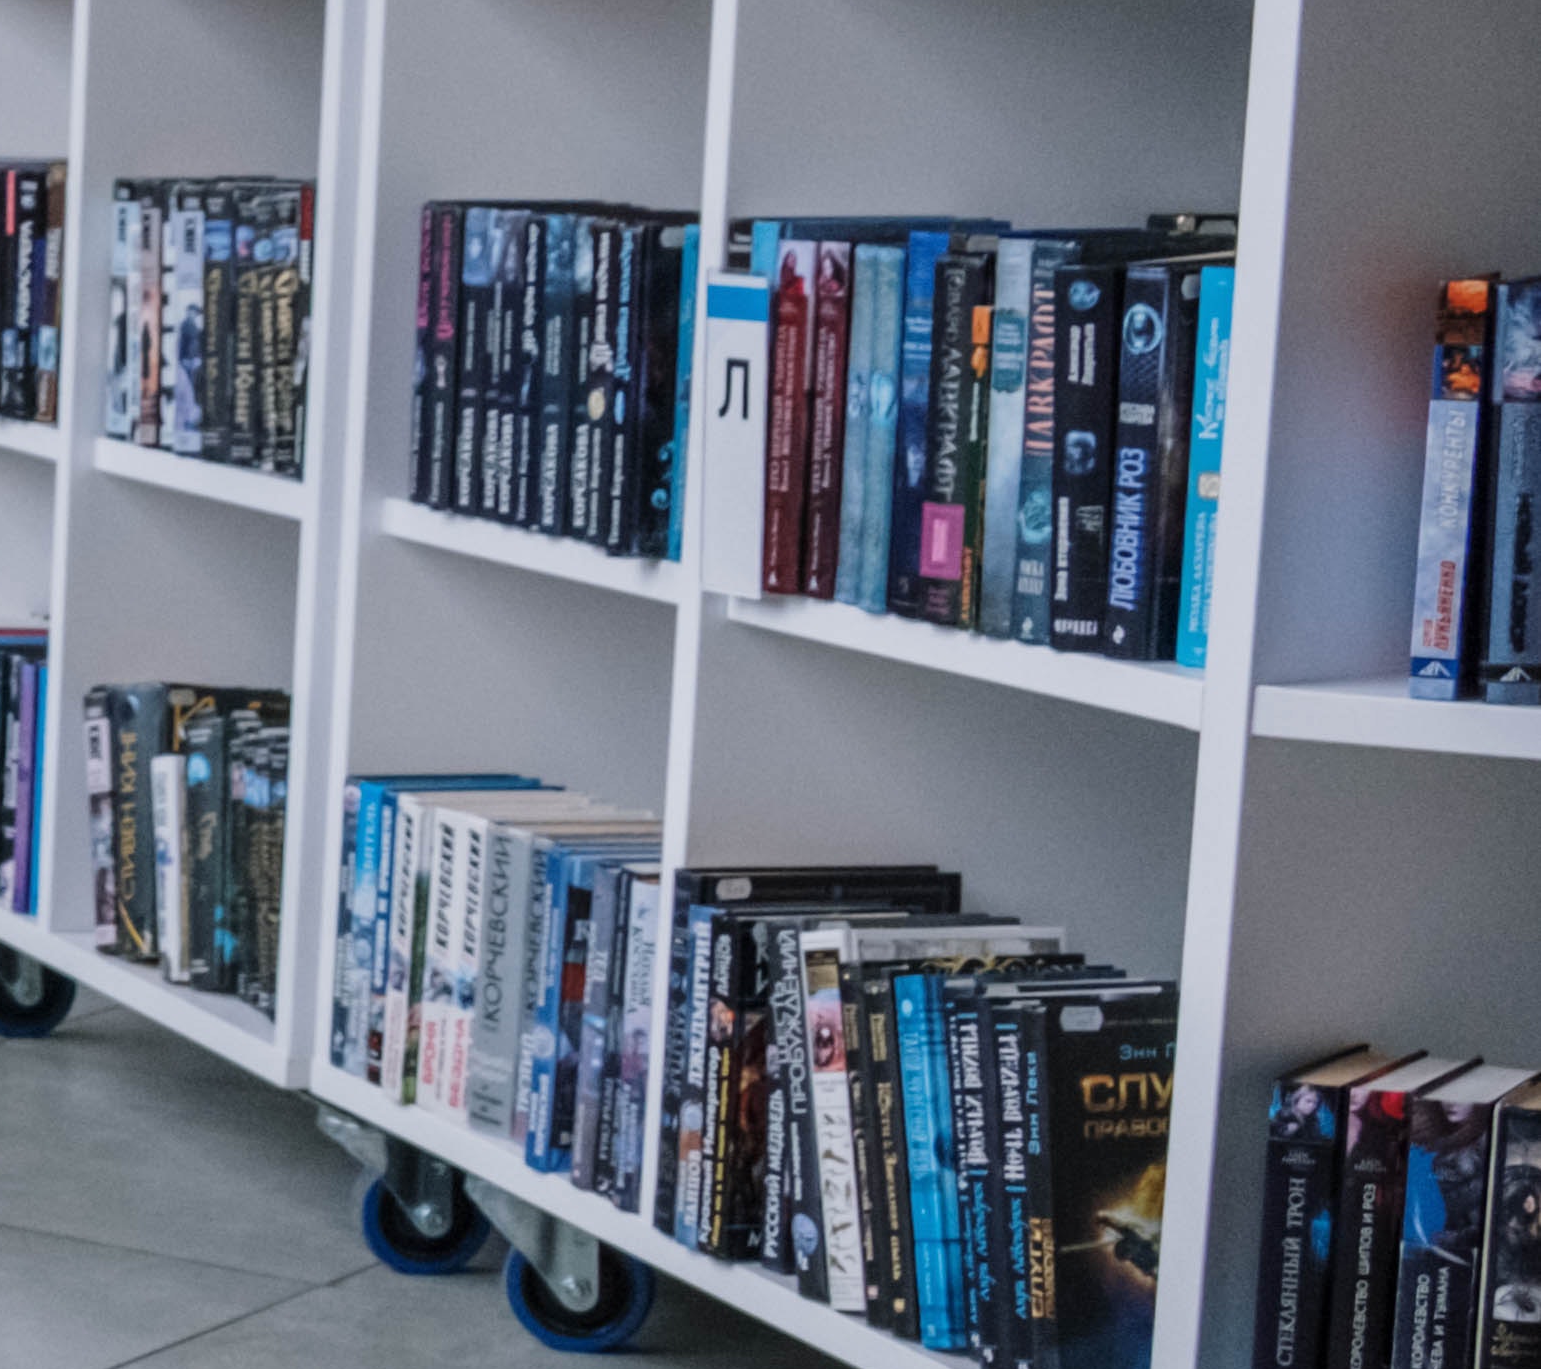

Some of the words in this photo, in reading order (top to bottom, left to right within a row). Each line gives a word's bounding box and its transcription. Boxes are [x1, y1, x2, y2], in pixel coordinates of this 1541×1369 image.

[718, 357, 750, 421] Л
[934, 347, 963, 503] ЛАВКРАФТ
[458, 406, 476, 507] КОРСАКОВА
[497, 413, 515, 514] КОРСАКОВА
[541, 423, 560, 527] КОРСАКОВА
[571, 423, 590, 528] КОРСАКОВА
[1117, 446, 1147, 489] РОЗ
[1436, 409, 1467, 530] КОНКУРЕНТЫ
[1056, 496, 1074, 568] вторжения
[1109, 493, 1145, 611] ЛЮБОВНИК
[1054, 569, 1070, 602] Зона
[393, 811, 415, 940] КОРЧЕВСКИЙ
[434, 820, 455, 949] КОРЧЕВСКИЙ
[461, 828, 482, 957] КОРЧЕВСКИЙ
[480, 835, 513, 1025] КОРЧЕВСКИЙ
[687, 921, 711, 1088] ЛЖЕДМИТРИЙ
[778, 930, 808, 1115] ПРОБУЖДЕНИЙ
[1025, 1050, 1039, 1105] Леки
[1079, 1072, 1175, 1113] СЛУ
[1118, 1044, 1158, 1062] Энн
[702, 1046, 721, 1155] Император
[767, 1089, 784, 1172] МЕДВЕДЬ
[683, 1149, 702, 1228] ЛАНЦОВ
[698, 1159, 714, 1244] Красный
[764, 1175, 781, 1258] РУССКИЙ
[1282, 1177, 1307, 1229] ТРОН
[1360, 1183, 1377, 1212] РОЗ
[1360, 1212, 1374, 1224] И
[1355, 1226, 1373, 1276] ШИПОВ
[1274, 1237, 1303, 1368] СТЕКЛЯННЫЙ
[1432, 1266, 1451, 1321] ТУМАНА
[1433, 1324, 1446, 1337] И
